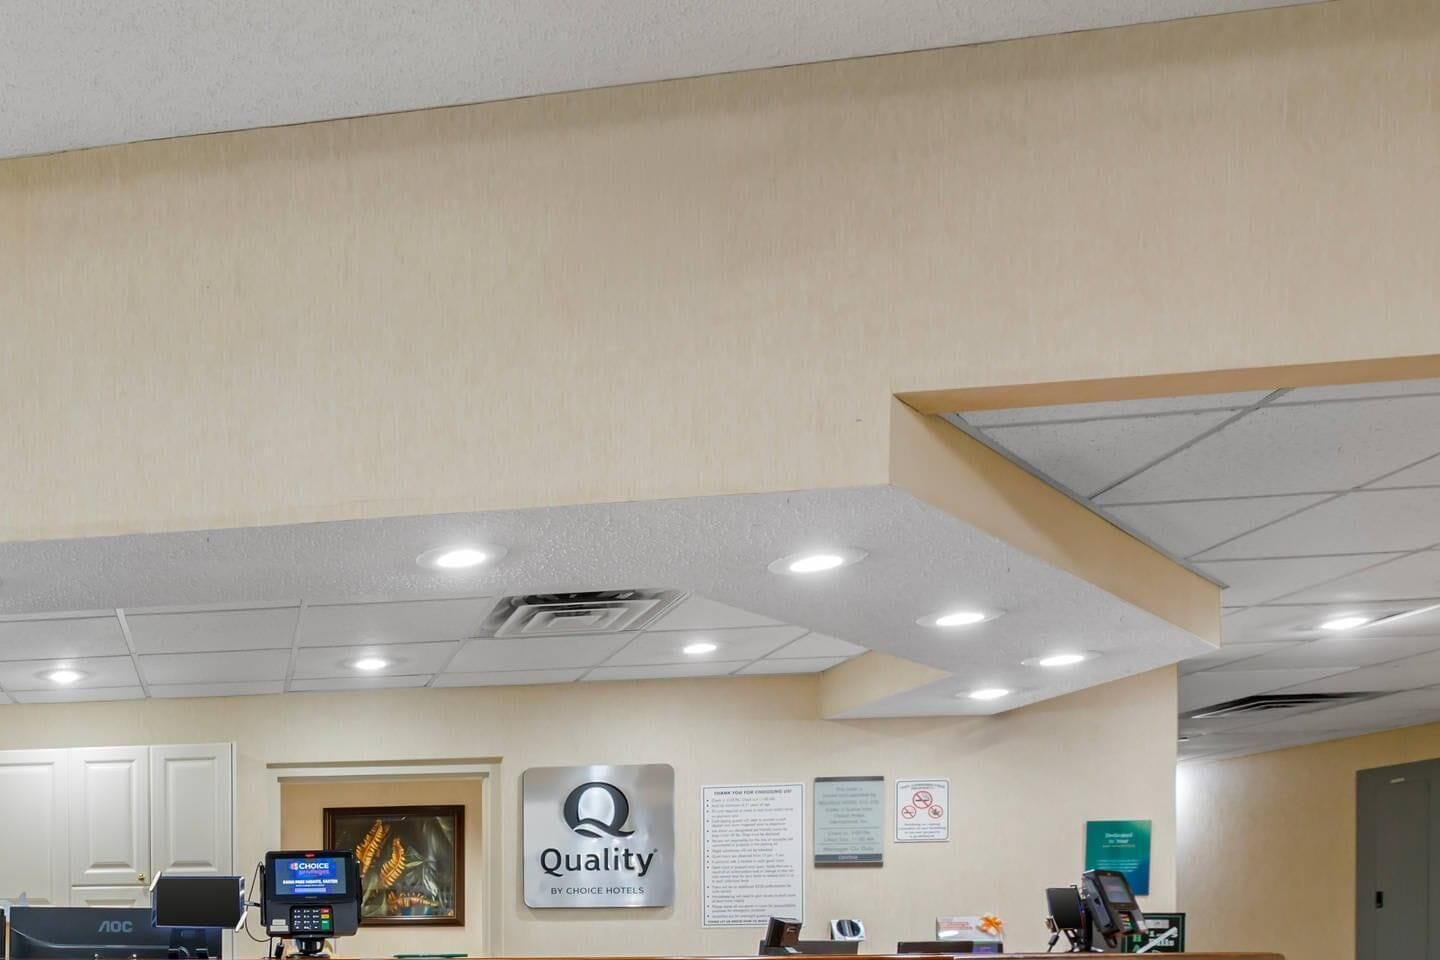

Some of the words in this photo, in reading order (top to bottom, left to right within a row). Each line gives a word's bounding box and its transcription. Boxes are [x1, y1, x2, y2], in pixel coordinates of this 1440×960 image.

[298, 862, 329, 870] CHOICE
[540, 847, 654, 877] Quality
[550, 887, 563, 895] BY
[565, 887, 603, 895] CHOICE
[606, 886, 645, 894] HOTELS
[98, 920, 133, 933] AOC
